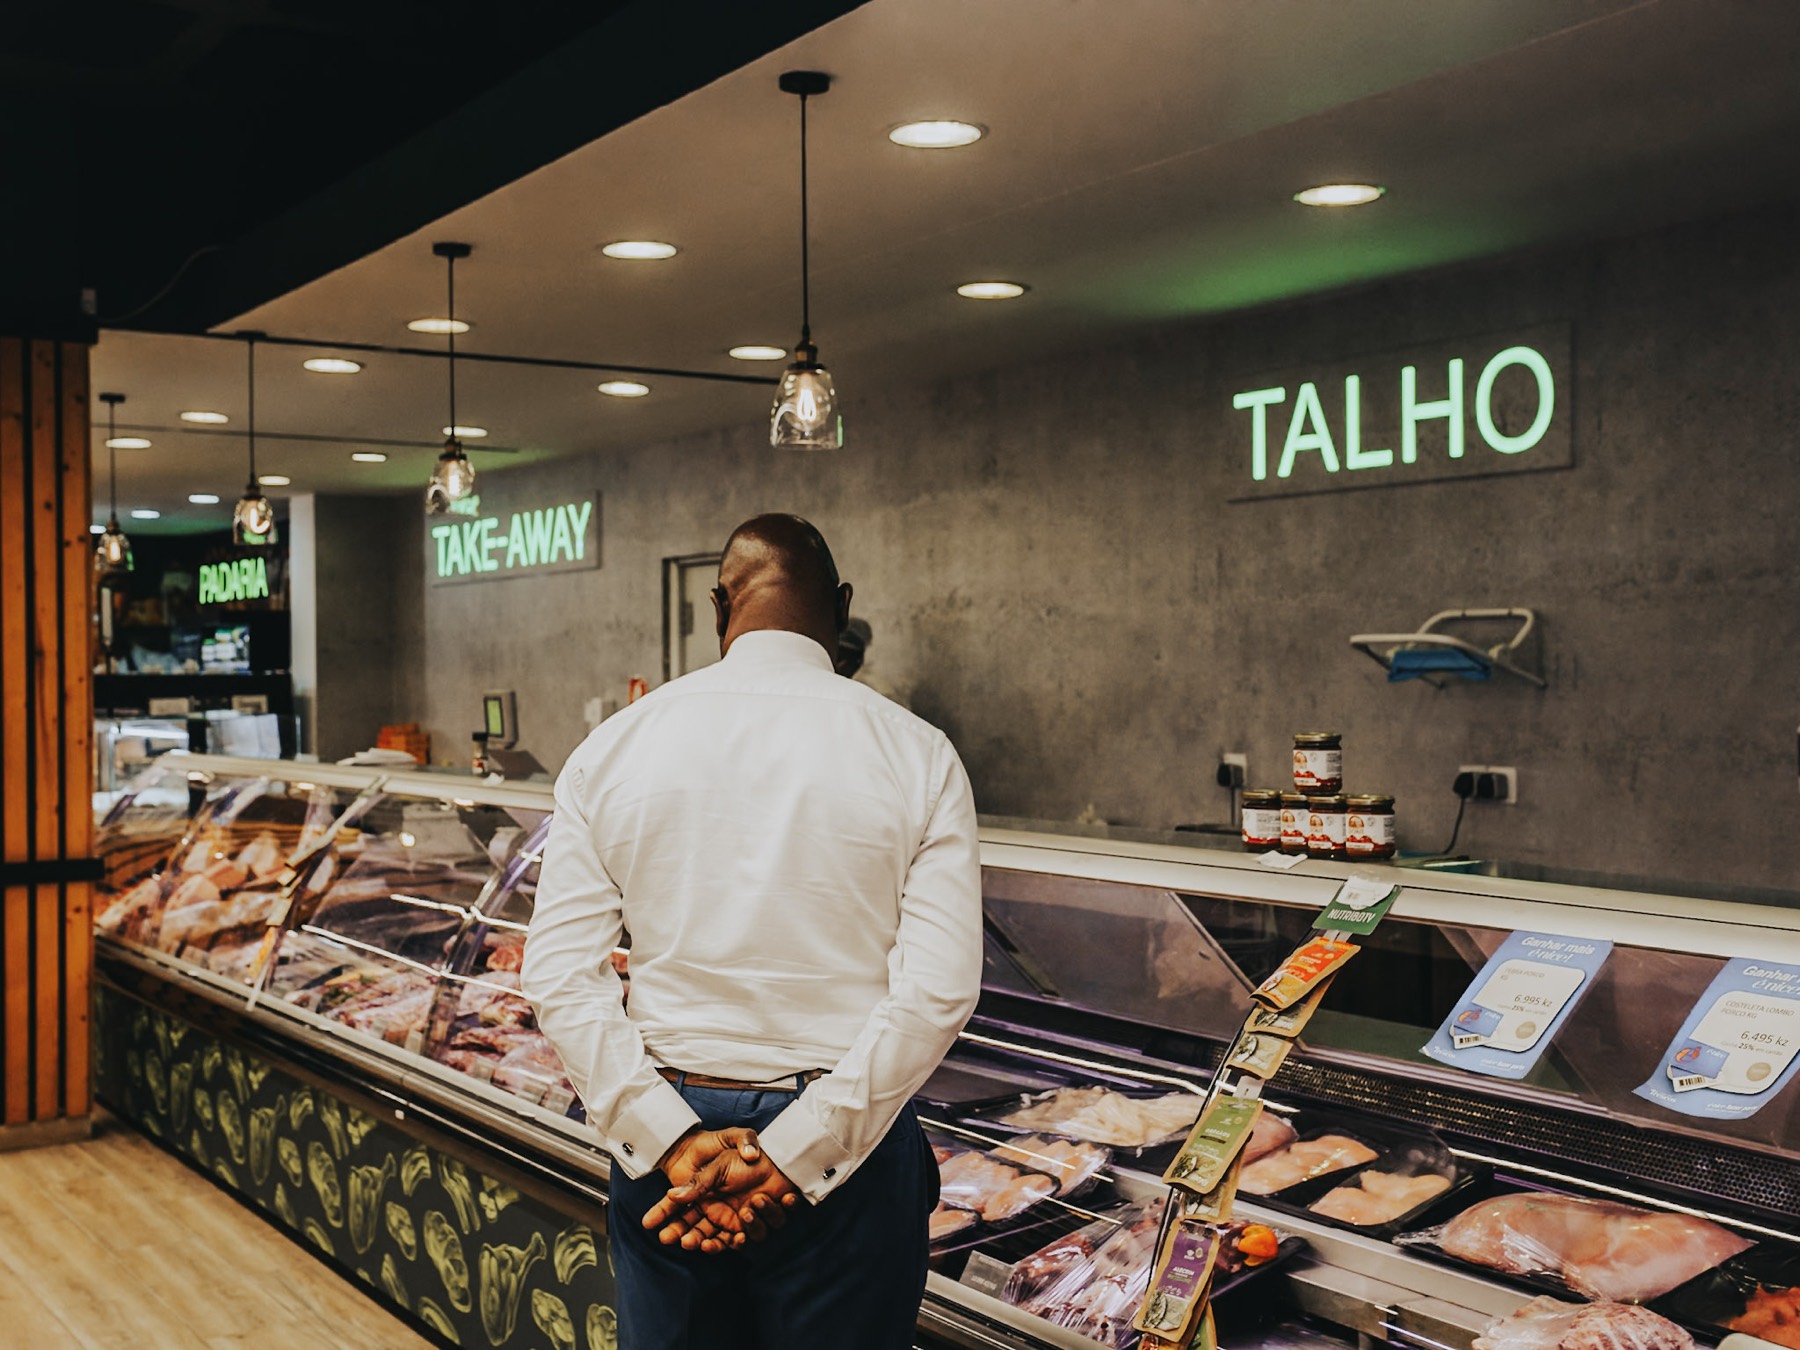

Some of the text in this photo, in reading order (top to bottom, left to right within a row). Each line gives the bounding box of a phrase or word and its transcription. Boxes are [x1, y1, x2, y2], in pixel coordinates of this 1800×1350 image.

[1233, 346, 1555, 481] TALHO
[431, 501, 592, 577] TAKE-AWAY
[199, 556, 269, 604] PADARIA
[1521, 936, 1596, 955] Ganhar mais
[1743, 965, 1798, 982] Ganhar
[1514, 994, 1541, 1006] 6.995
[1725, 1000, 1796, 1017] COSTELETA LOMBO
[1738, 1042, 1755, 1051] 25%
[1740, 1030, 1789, 1047] 6.495 kz
